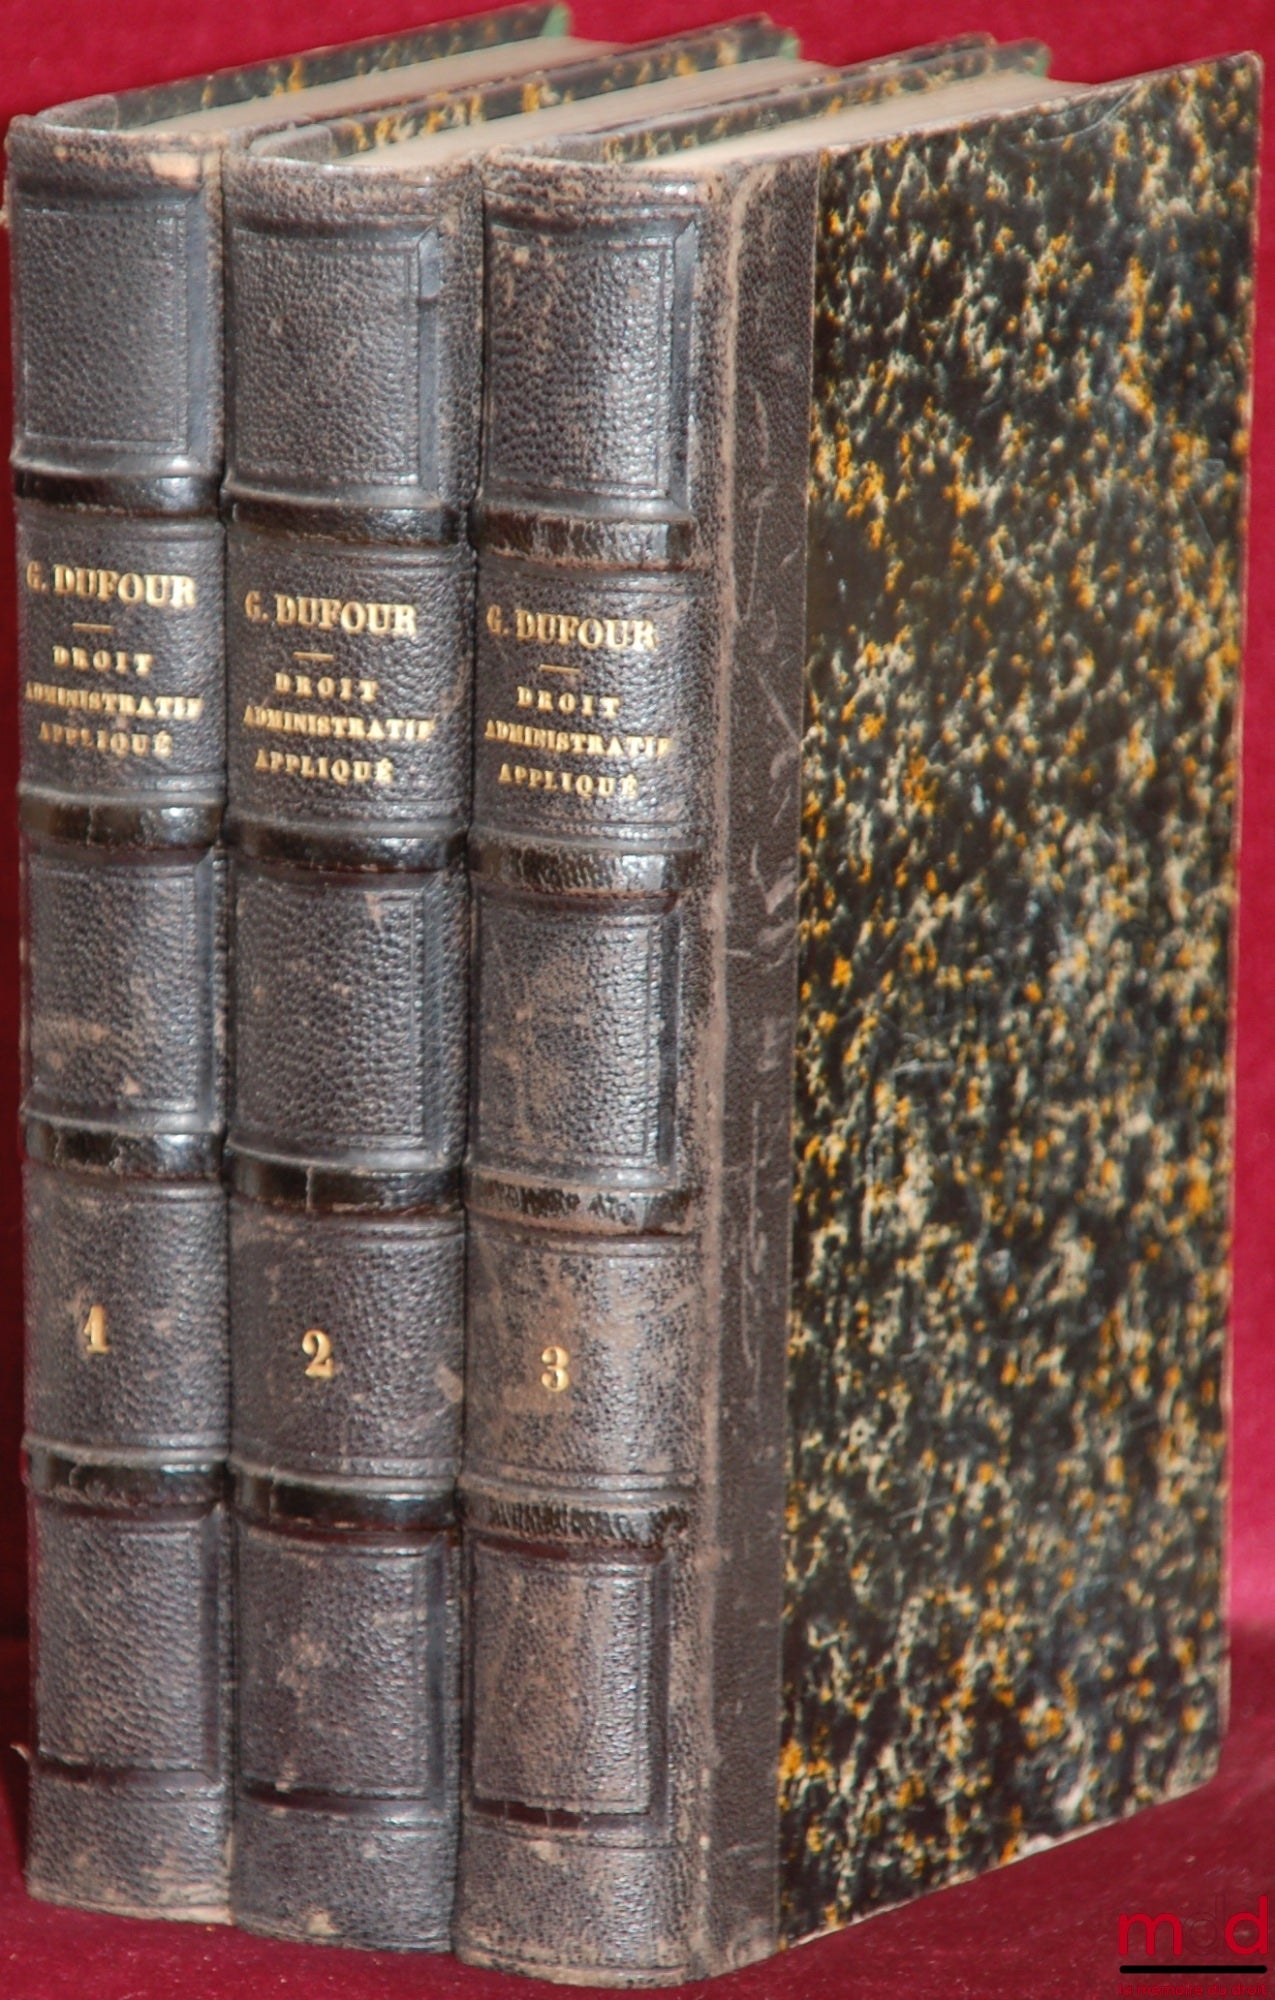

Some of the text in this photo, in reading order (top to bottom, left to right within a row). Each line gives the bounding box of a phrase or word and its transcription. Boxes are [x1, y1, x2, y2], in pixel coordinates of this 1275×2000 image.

[53, 563, 196, 608] DUFOUR
[274, 593, 417, 636] DUFOUR
[515, 608, 659, 652] DUFOUR
[53, 645, 154, 676] DROIT
[25, 680, 203, 720] ADMINISTRATIF
[275, 672, 379, 703] DROIT
[517, 685, 621, 719] DROIT
[243, 704, 435, 741] ADMINISTRATIF
[484, 719, 673, 757] ADMINISTRATIF
[83, 1304, 110, 1354] 1
[302, 1329, 336, 1379] 2
[540, 1345, 570, 1393] 3
